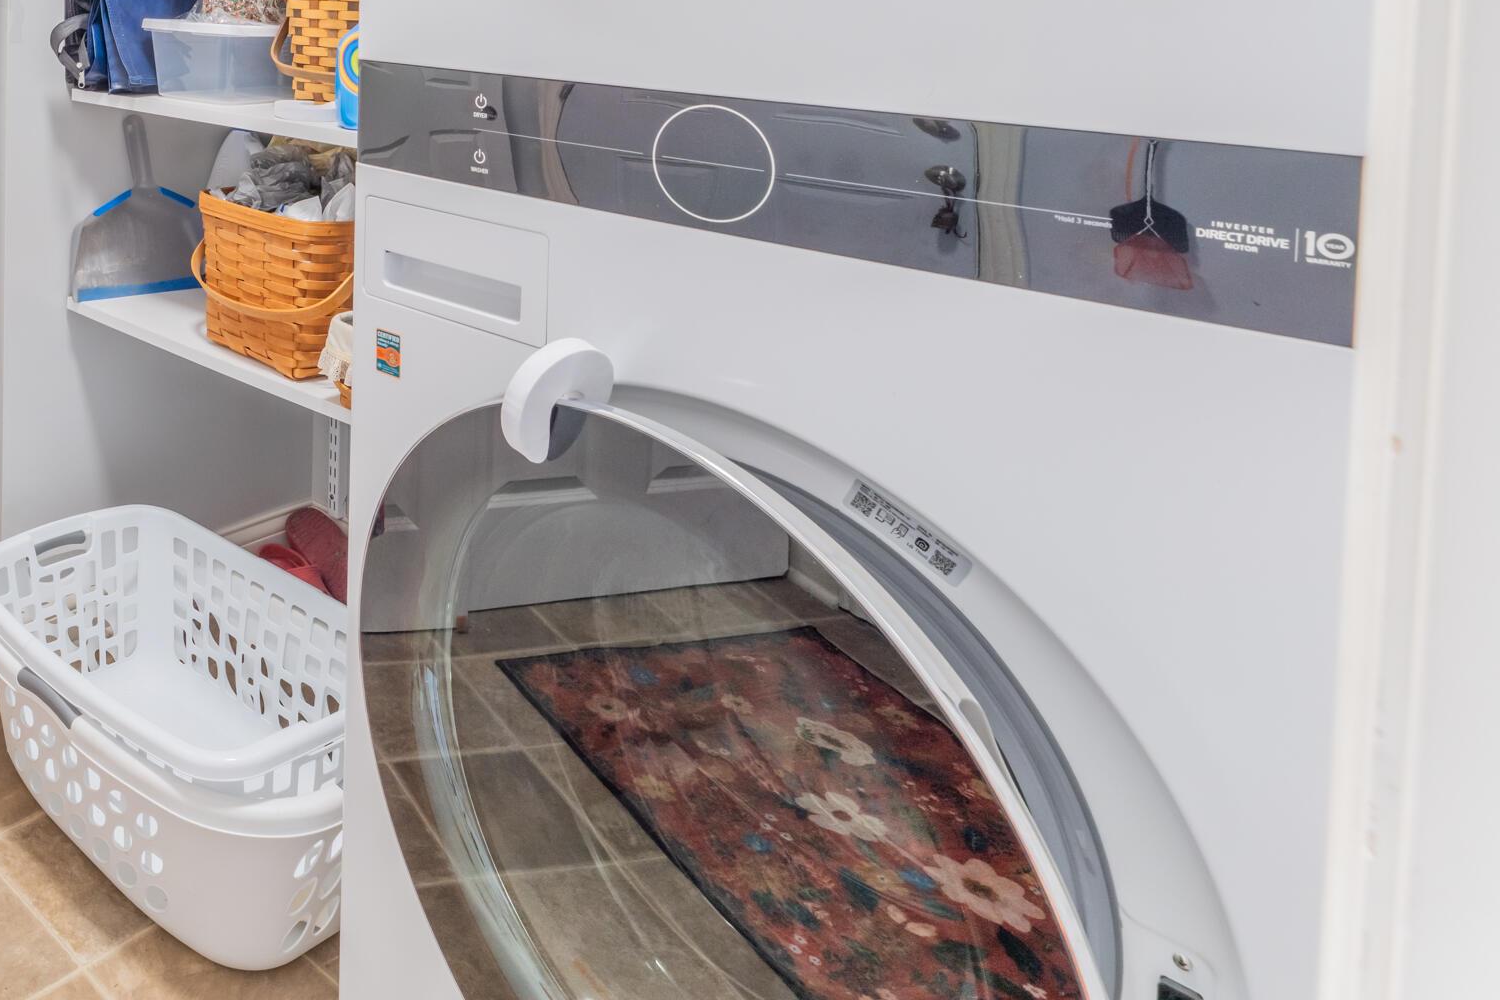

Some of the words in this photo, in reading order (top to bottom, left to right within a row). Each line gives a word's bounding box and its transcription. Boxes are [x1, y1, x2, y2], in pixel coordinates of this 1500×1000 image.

[1211, 220, 1275, 235] INVERTER
[1195, 227, 1245, 243] DIRECT
[1246, 234, 1291, 250] DRIVE
[1304, 230, 1356, 261] 10
[1224, 241, 1259, 254] MOTOR
[1305, 256, 1353, 269] WARRANTY
